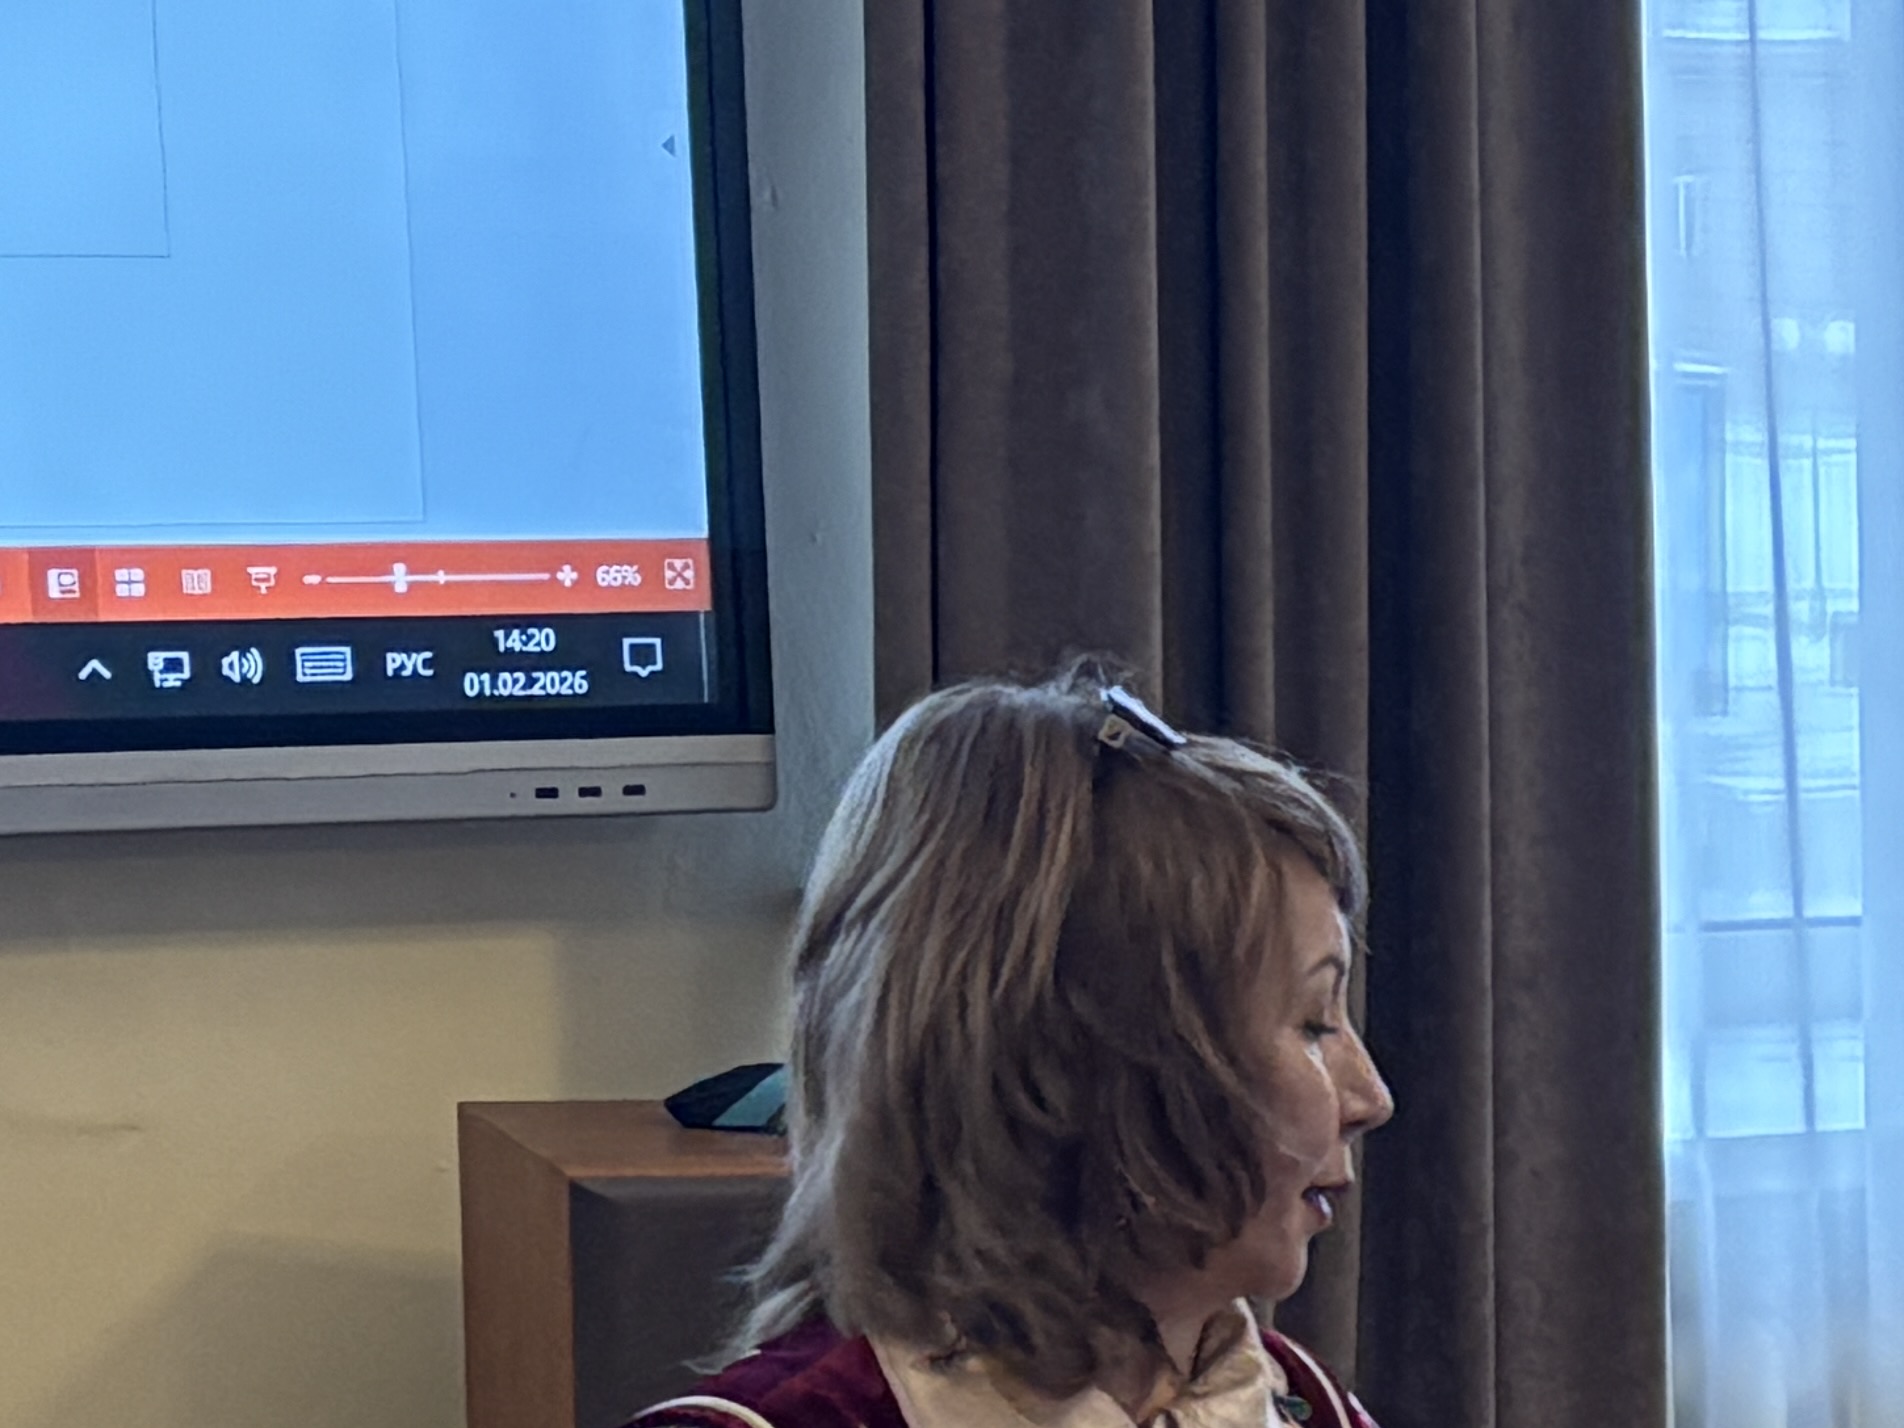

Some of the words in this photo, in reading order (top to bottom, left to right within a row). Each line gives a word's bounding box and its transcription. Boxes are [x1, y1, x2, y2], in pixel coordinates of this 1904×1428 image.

[493, 628, 556, 653] 14:20
[385, 651, 435, 677] РУС
[463, 670, 589, 697] 01.02.2026
